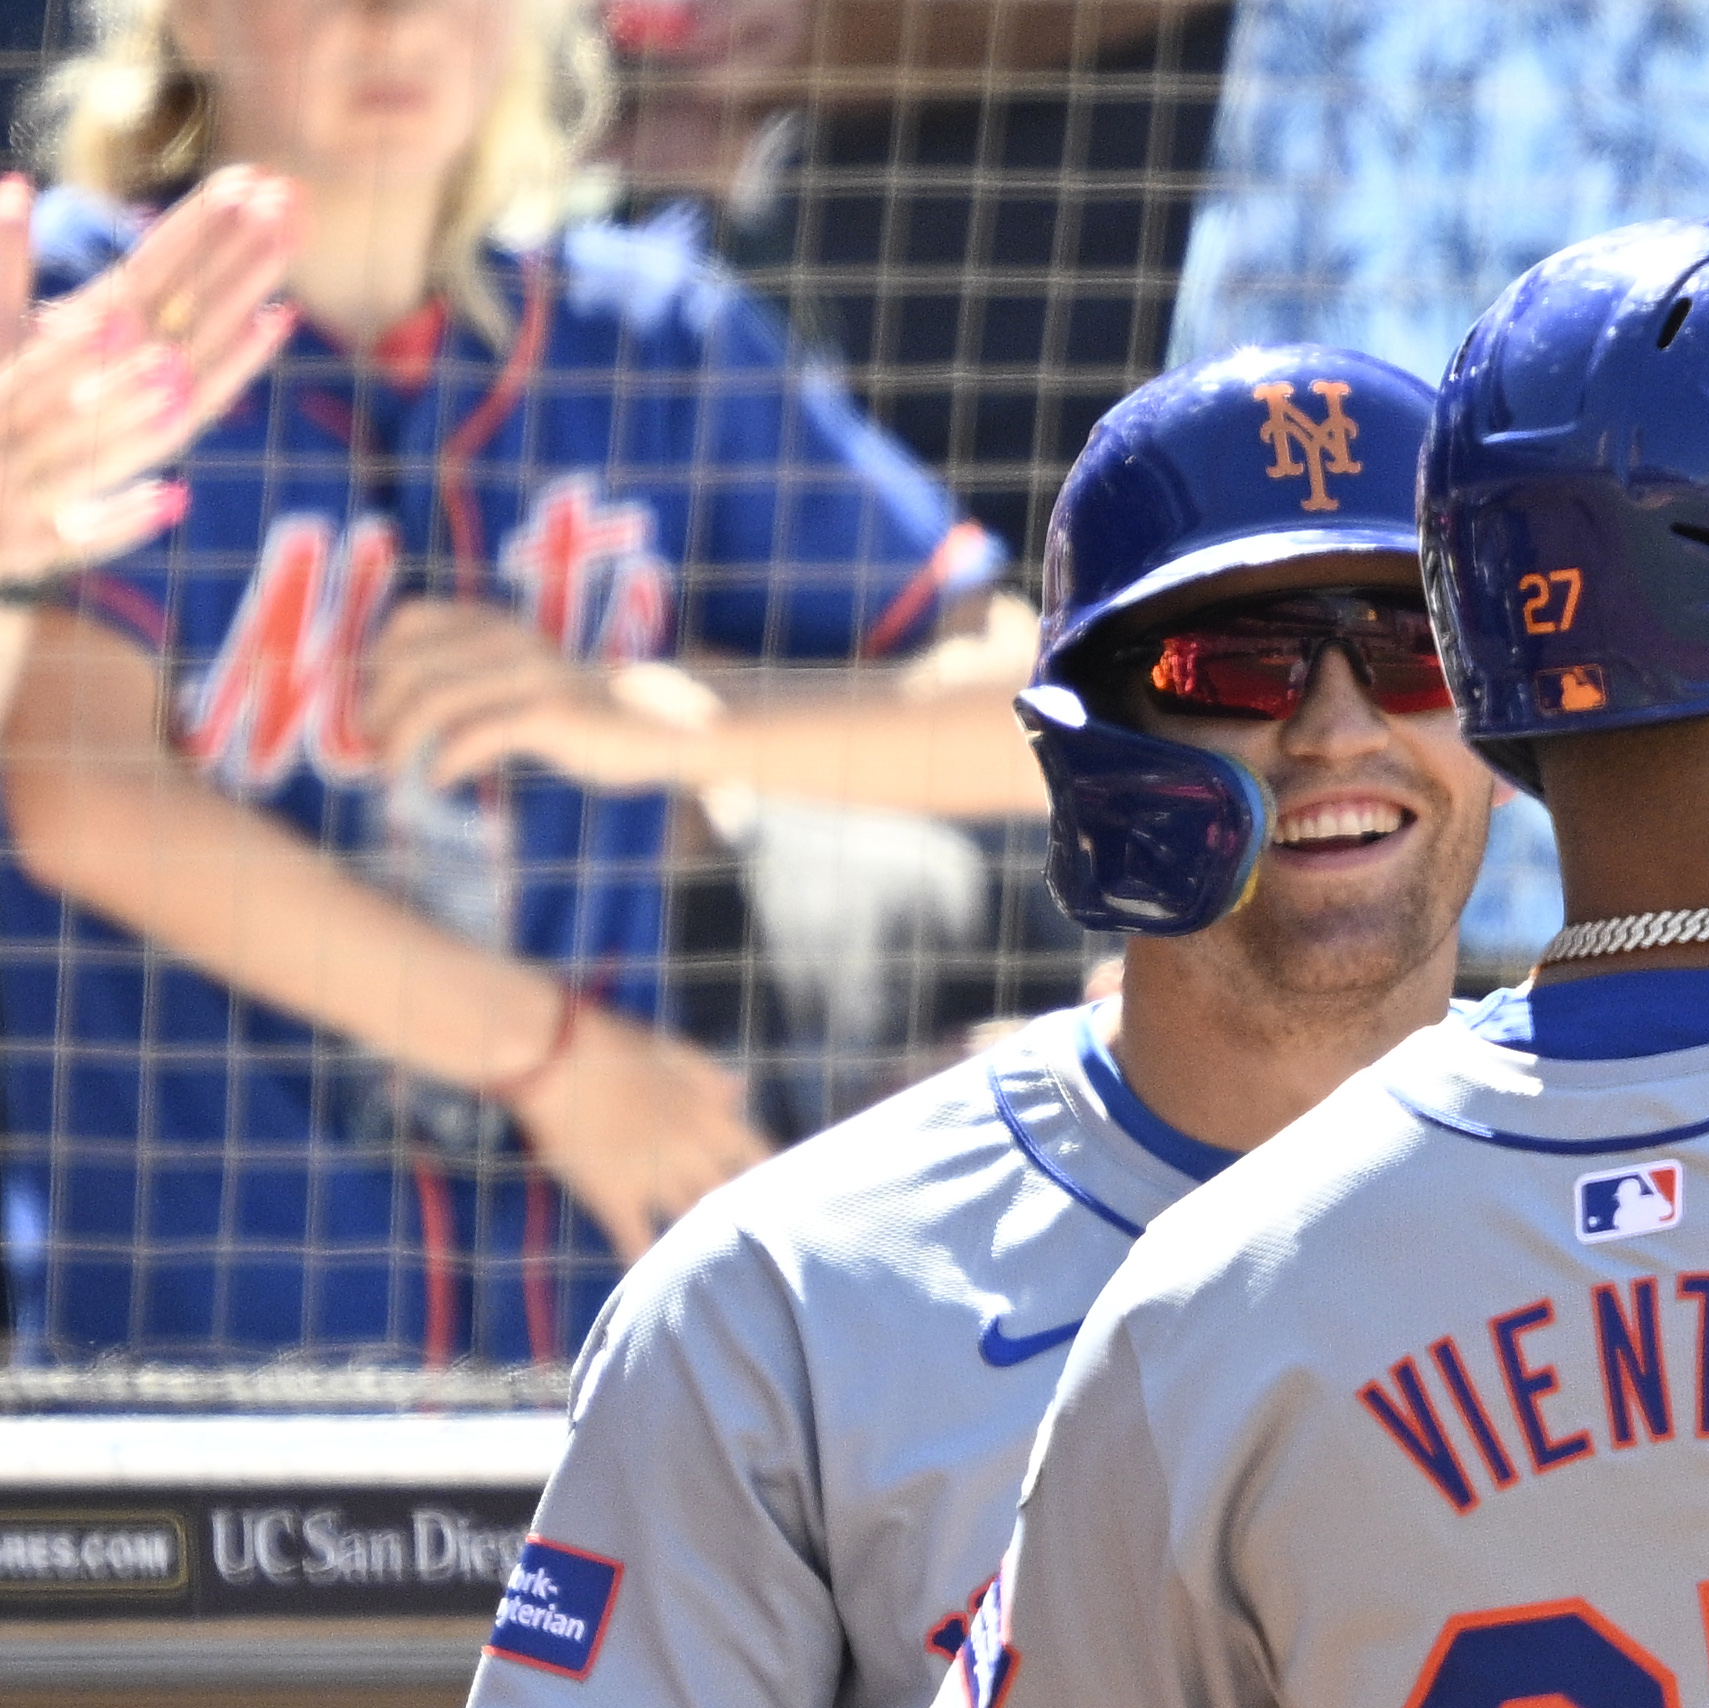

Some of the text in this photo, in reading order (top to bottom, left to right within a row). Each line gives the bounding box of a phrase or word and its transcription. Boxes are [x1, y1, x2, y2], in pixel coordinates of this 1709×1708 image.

[1518, 566, 1585, 635] 27
[209, 1506, 300, 1584] UC
[302, 1507, 402, 1584] San
